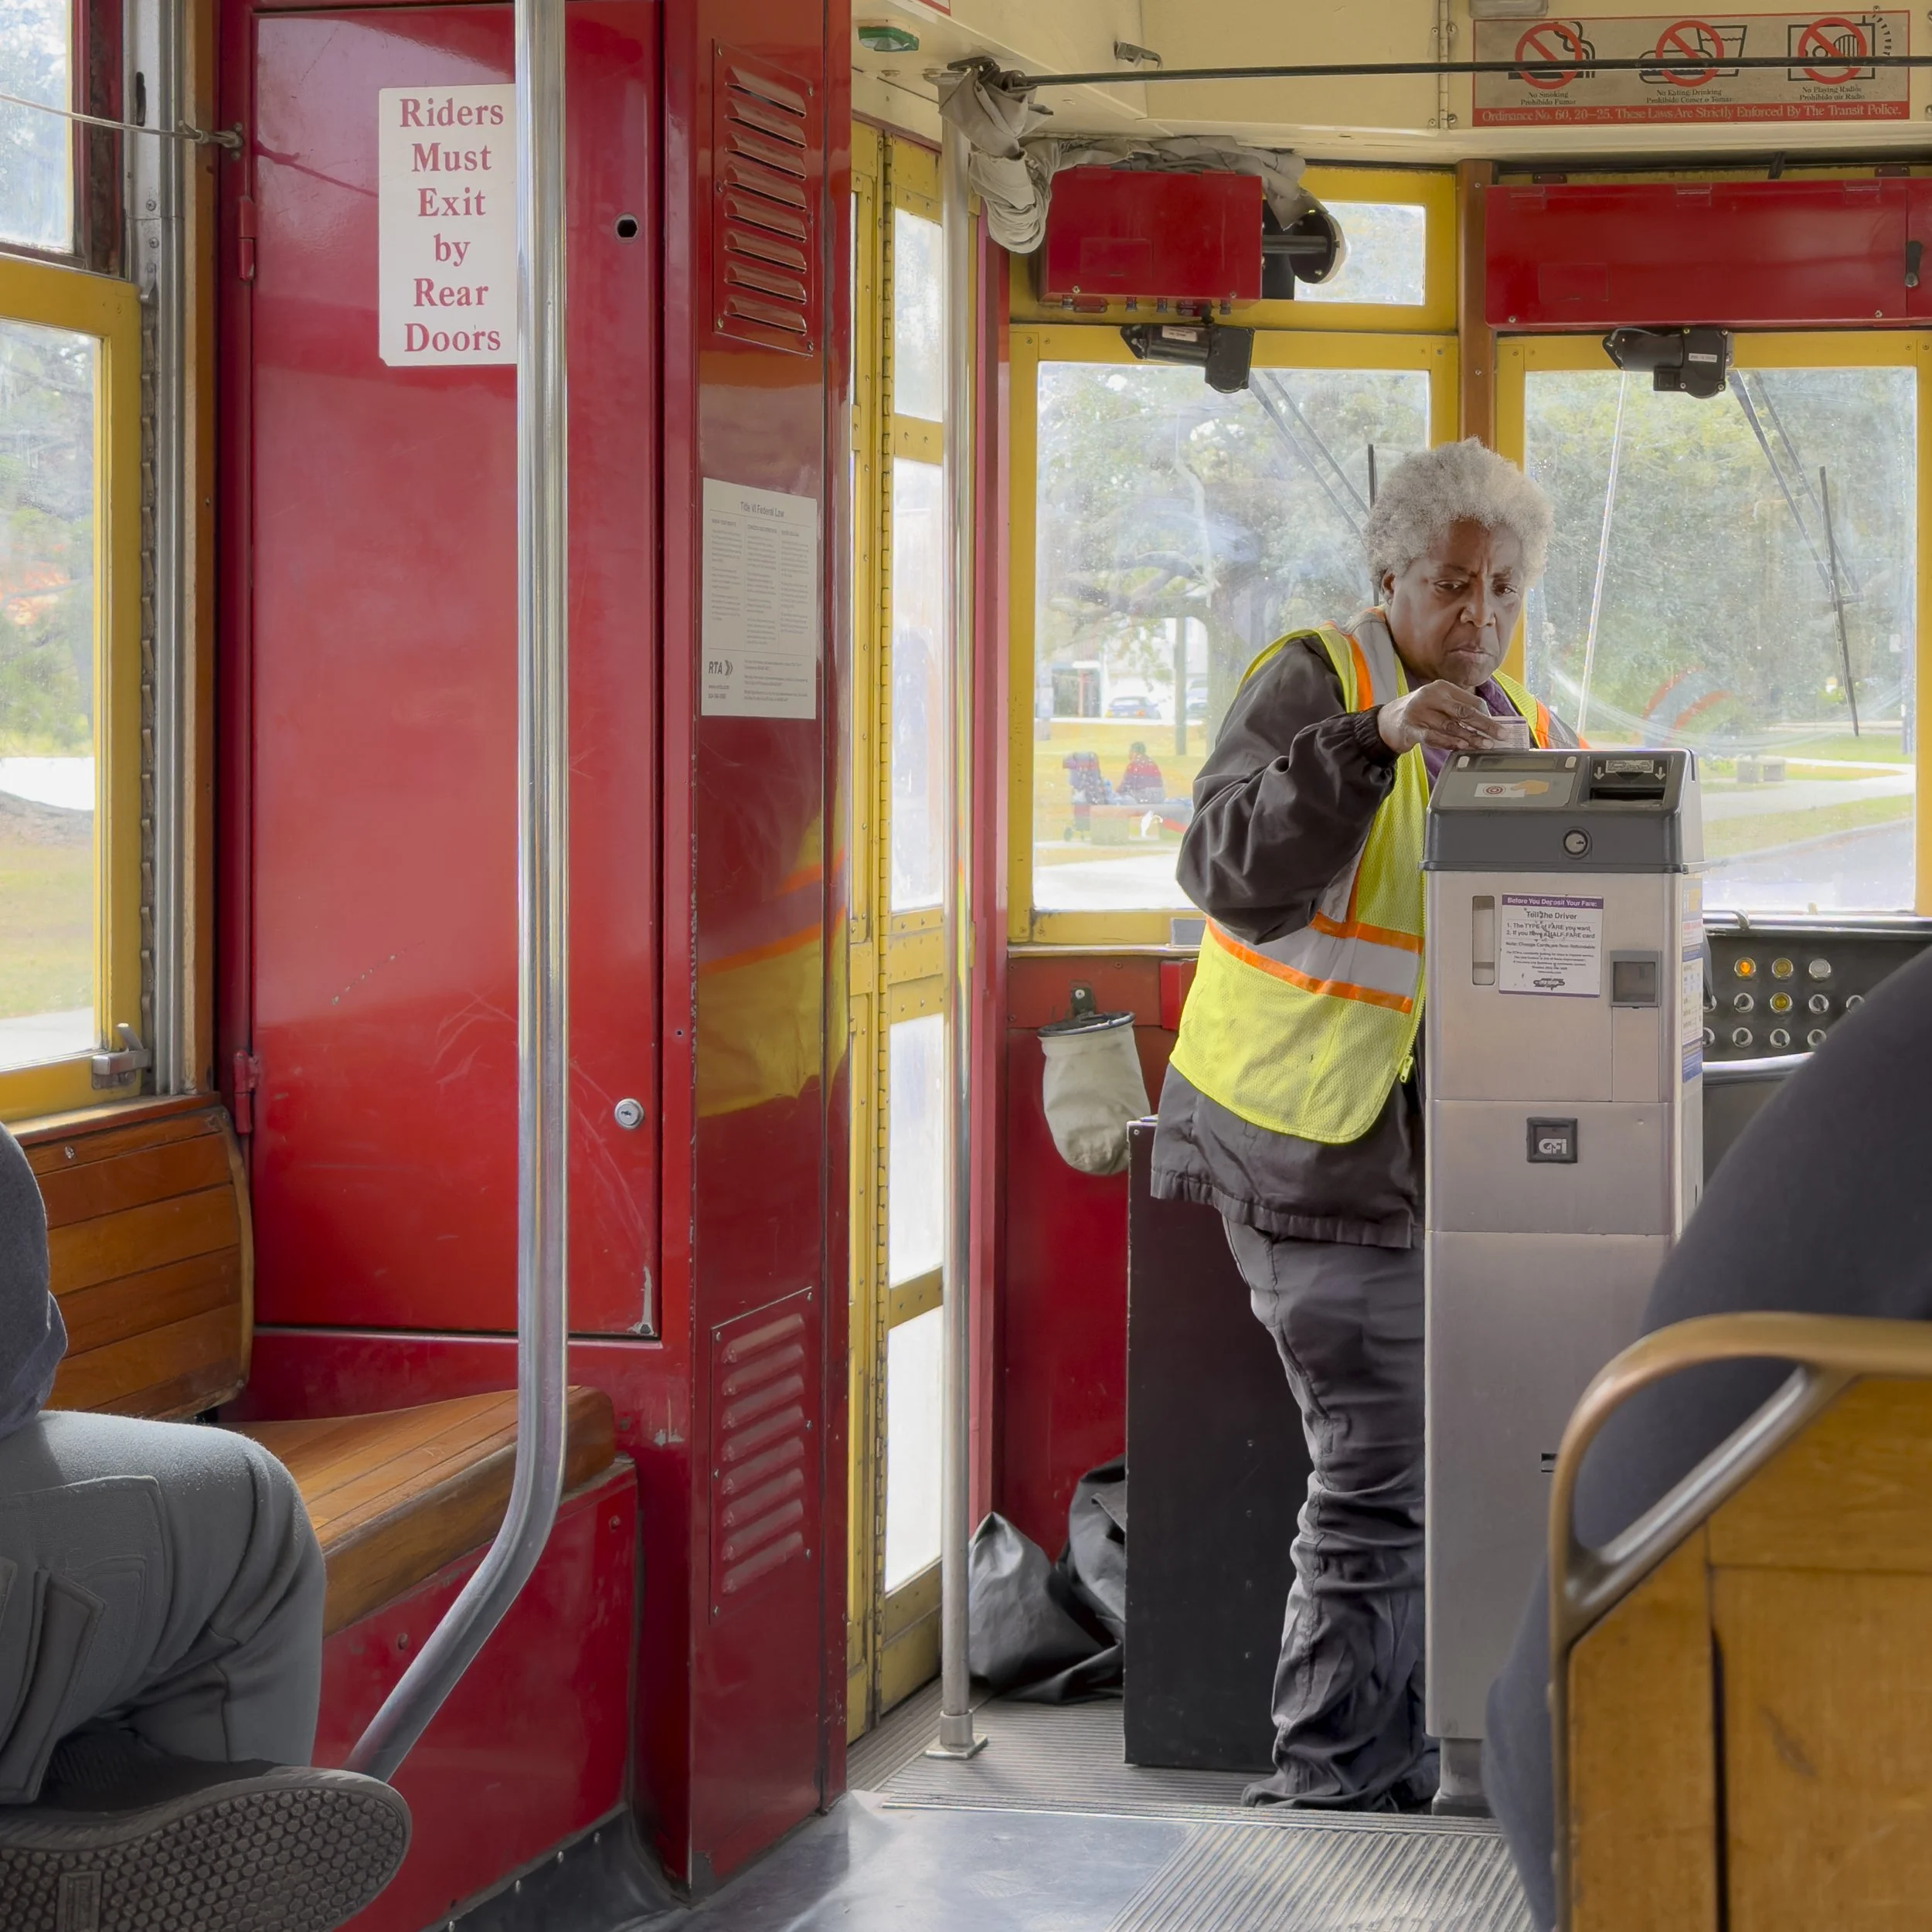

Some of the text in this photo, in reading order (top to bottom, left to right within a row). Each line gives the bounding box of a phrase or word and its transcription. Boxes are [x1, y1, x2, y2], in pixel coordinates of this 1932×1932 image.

[400, 97, 504, 127] Riders
[1482, 111, 1533, 121] Ordinance
[1535, 110, 1552, 121] No.
[1616, 108, 1645, 119] These
[1648, 107, 1672, 119] Laws
[1675, 107, 1693, 118] Are
[1696, 105, 1734, 118] Strictly
[1737, 105, 1783, 117] Enforced
[1787, 104, 1801, 117] By
[1804, 104, 1824, 116] The
[1827, 104, 1863, 115] Transit
[1867, 103, 1902, 115] Police.
[412, 142, 492, 172] Must
[418, 187, 486, 216] Exit
[434, 233, 471, 267] by
[413, 278, 489, 307] Rear
[404, 323, 501, 352] Doors
[757, 505, 774, 516] Federal
[708, 661, 723, 675] RTA
[1539, 1138, 1566, 1154] GFI
